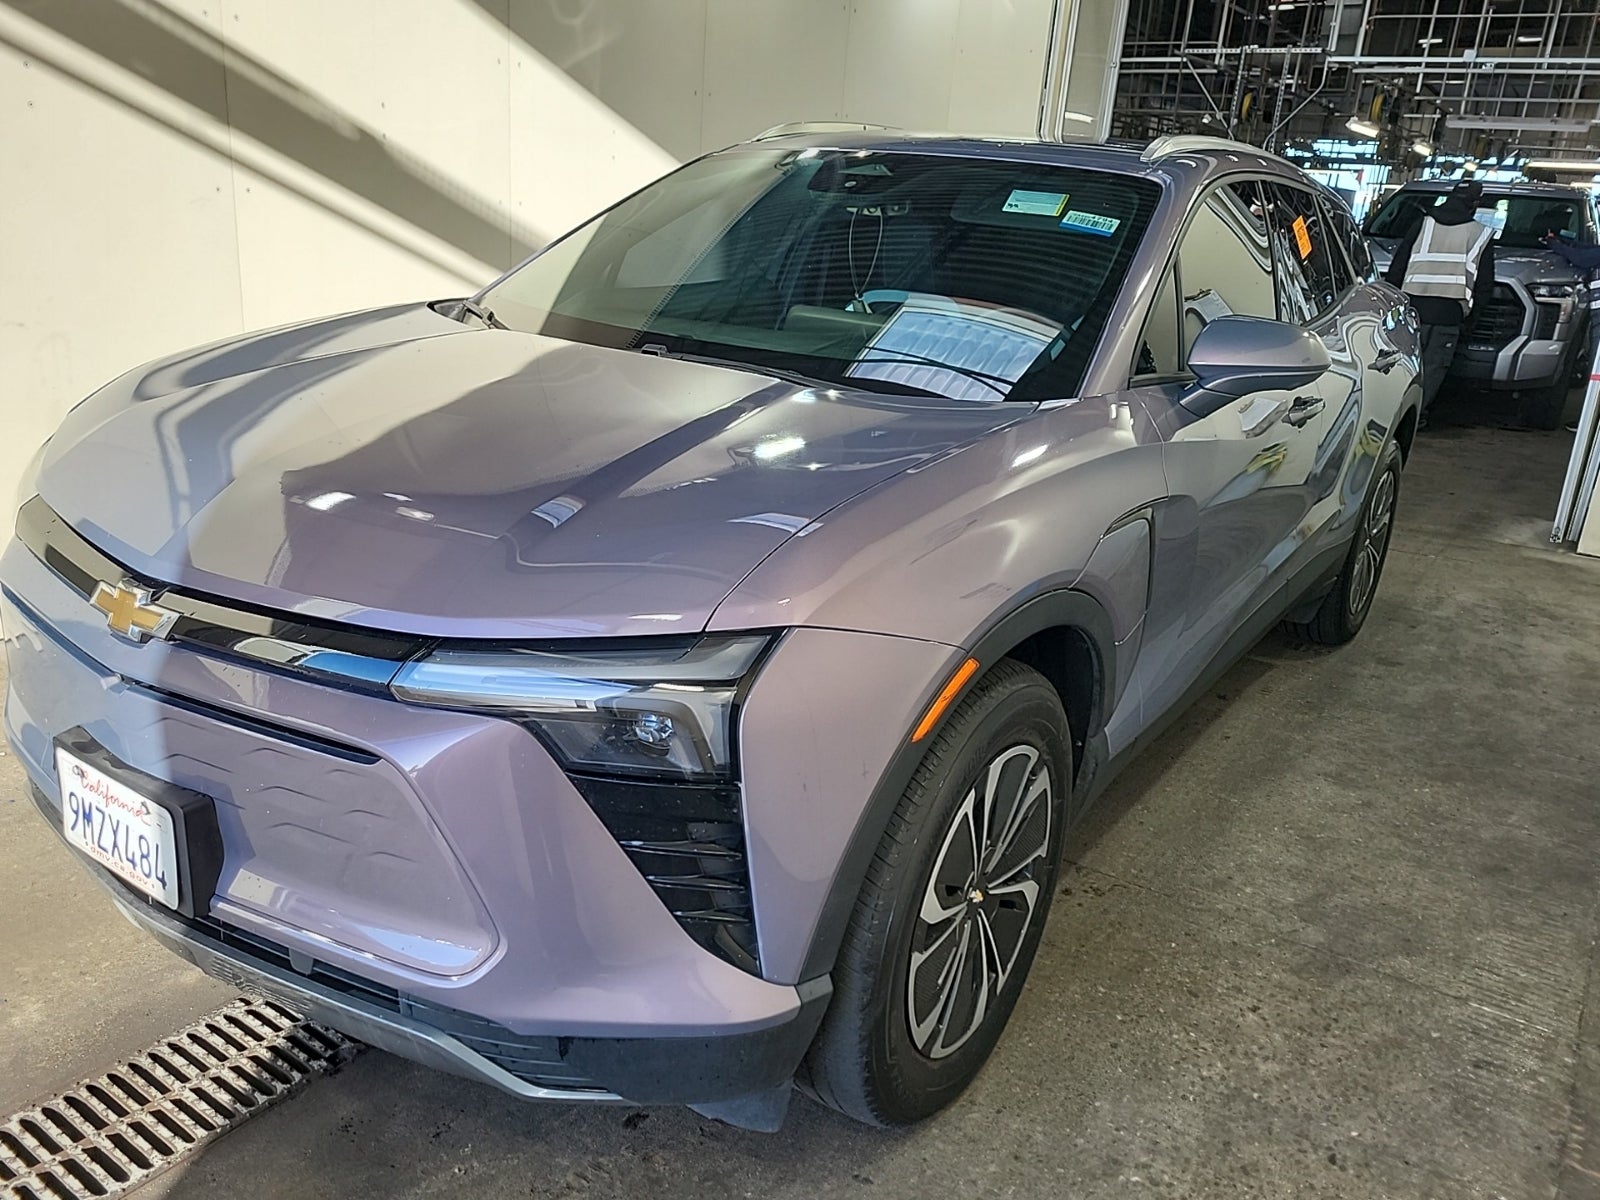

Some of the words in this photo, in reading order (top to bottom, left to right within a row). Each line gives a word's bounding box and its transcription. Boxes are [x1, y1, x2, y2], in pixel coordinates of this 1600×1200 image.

[80, 769, 151, 826] California
[69, 791, 167, 890] 9MZX484
[90, 845, 148, 885] dmv.ca.gov
